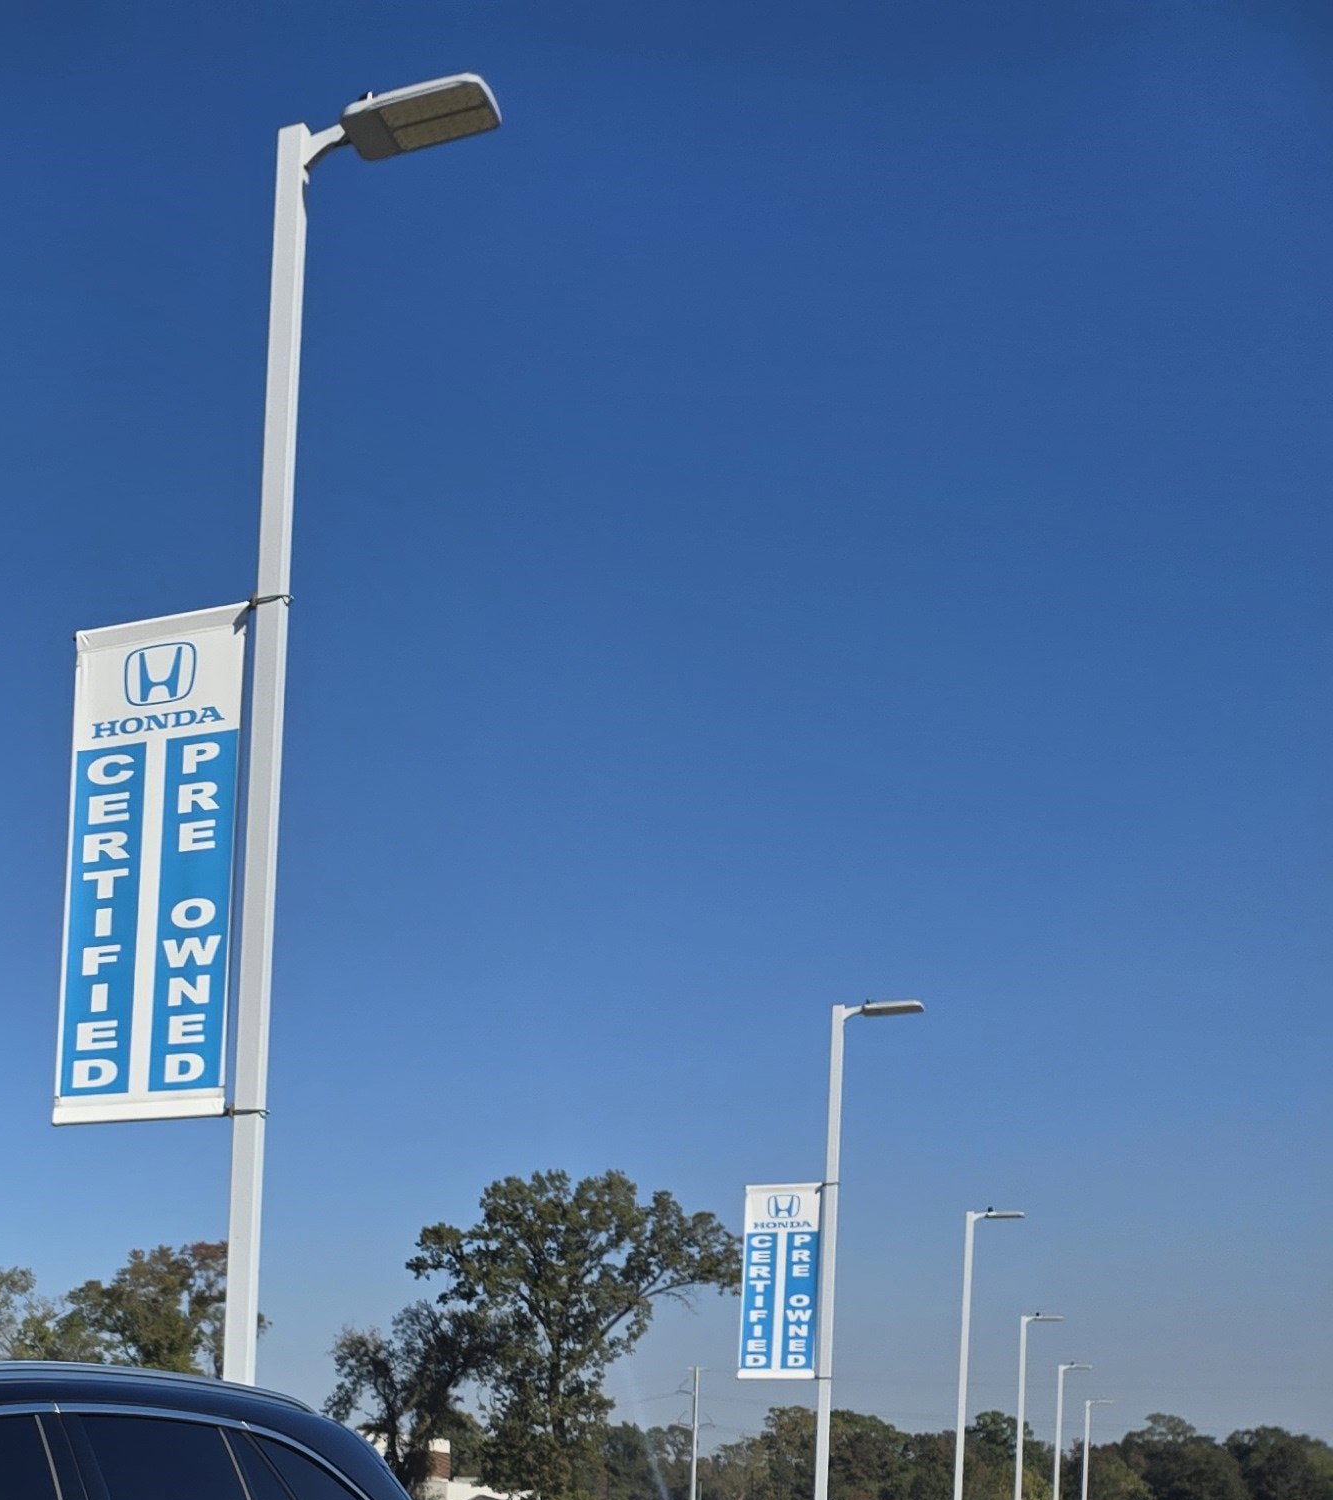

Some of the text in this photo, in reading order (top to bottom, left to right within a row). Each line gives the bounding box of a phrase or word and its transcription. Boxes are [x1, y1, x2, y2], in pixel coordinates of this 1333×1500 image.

[91, 706, 225, 739] HONDA
[71, 754, 135, 1089] CERTIFIED
[162, 742, 221, 1084] PRE OWNED
[753, 1221, 812, 1229] HONDA
[745, 1235, 773, 1367] CERTIFIED
[786, 1234, 812, 1367] PRE OWNED
